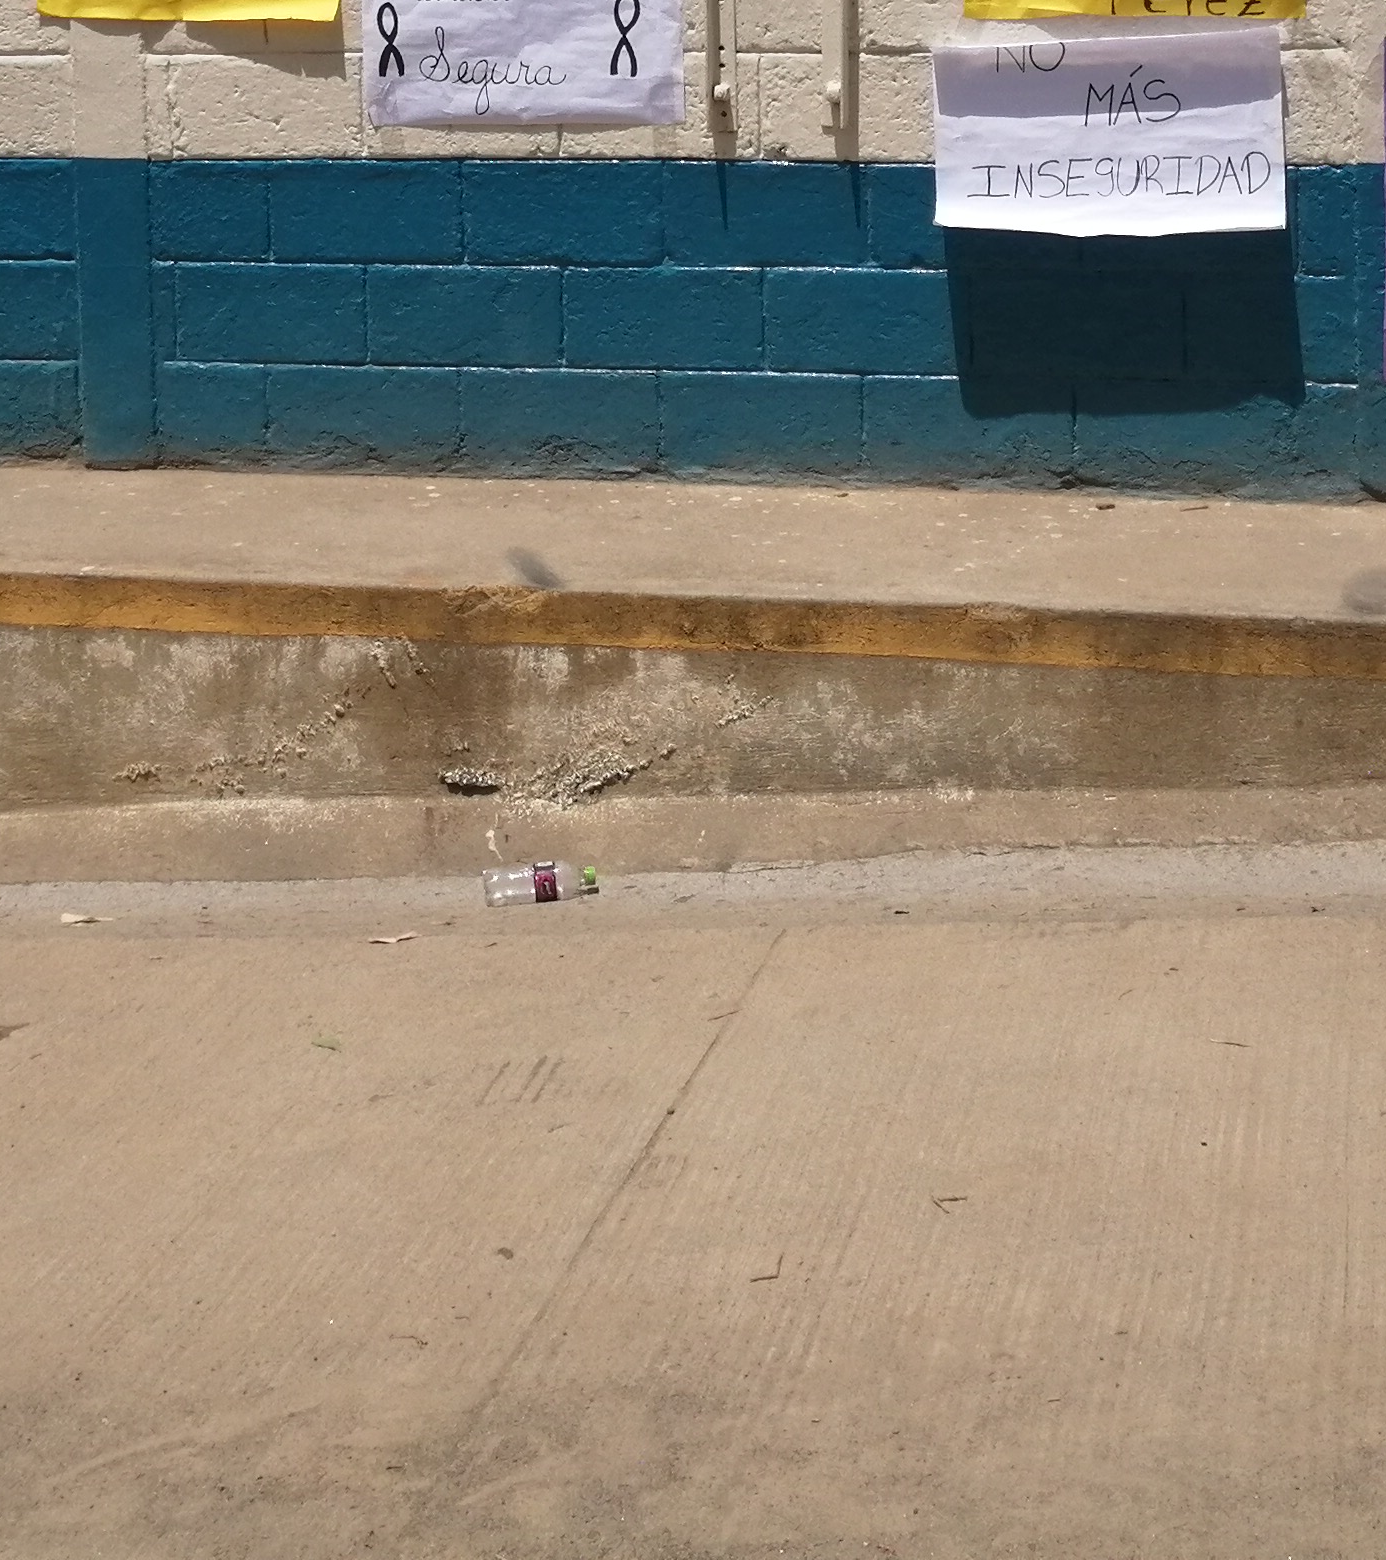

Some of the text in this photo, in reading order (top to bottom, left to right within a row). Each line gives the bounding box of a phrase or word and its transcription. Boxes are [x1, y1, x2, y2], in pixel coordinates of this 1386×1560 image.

[418, 26, 568, 116] Segura
[995, 41, 1068, 74] NO
[1084, 64, 1182, 128] MÁS
